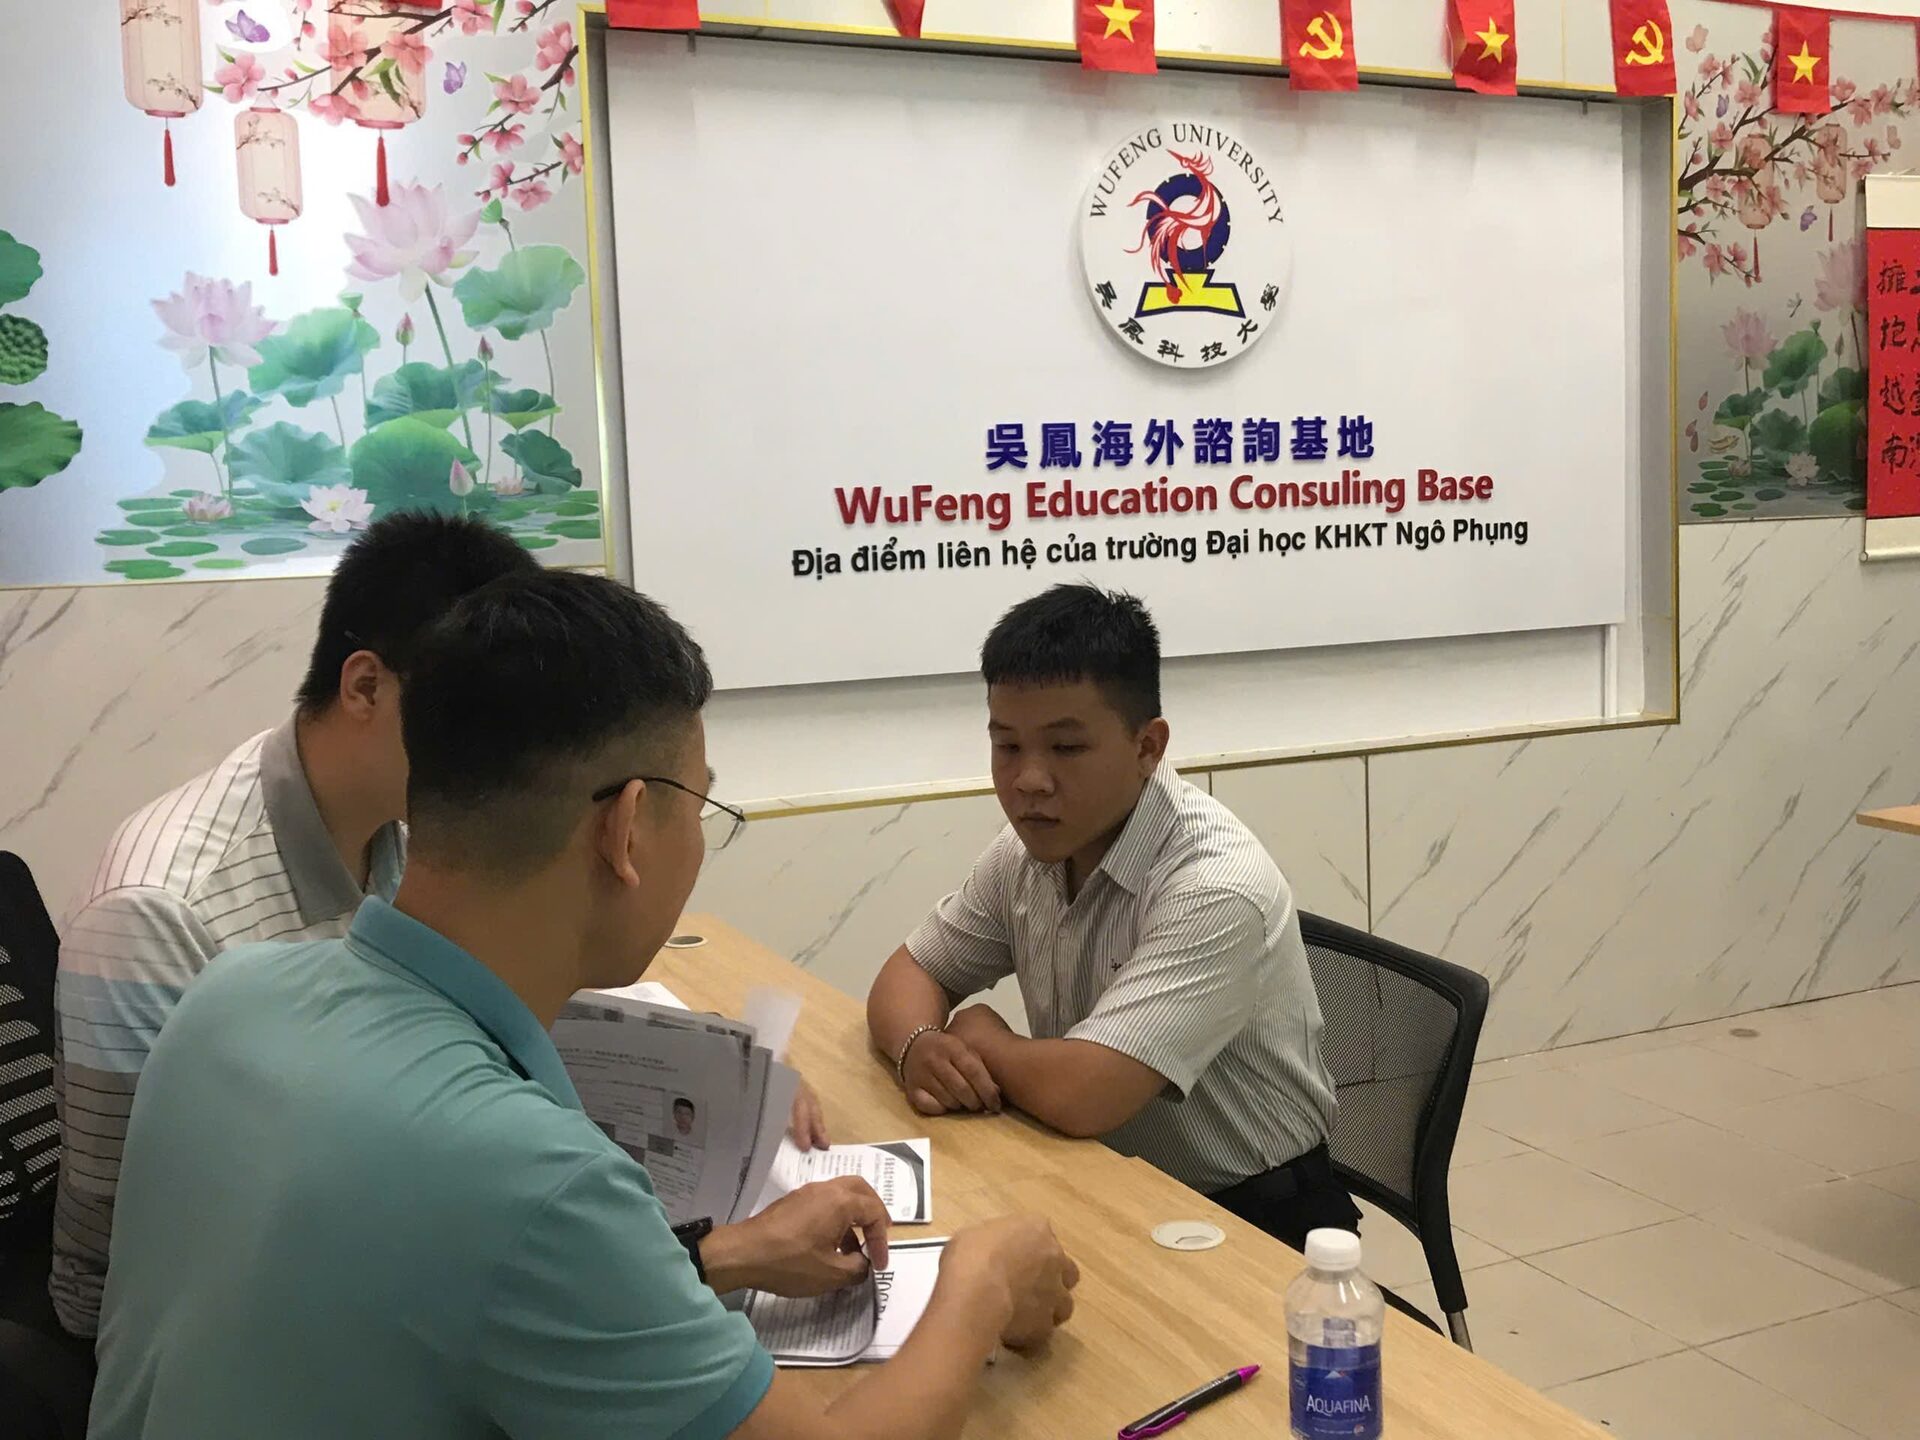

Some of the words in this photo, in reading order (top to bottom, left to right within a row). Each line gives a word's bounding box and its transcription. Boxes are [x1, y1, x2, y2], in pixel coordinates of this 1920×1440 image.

[1090, 128, 1162, 219] WUFENG
[1172, 123, 1284, 225] UNIVERSITY
[985, 414, 1375, 470] 吳鳳海外諮詢基地
[834, 484, 1012, 531] WuFeng
[1026, 475, 1218, 519] Education
[1229, 469, 1406, 514] Consuling
[1417, 468, 1494, 502] Base
[791, 547, 842, 580] Địa
[850, 536, 926, 573] điểm
[937, 540, 991, 569] liên
[1001, 540, 1038, 570] hệ
[1046, 533, 1097, 563] của
[1105, 532, 1197, 563] trường
[1206, 528, 1249, 559] Đại
[1258, 528, 1306, 557] học
[1315, 522, 1388, 549] KHKT
[1395, 518, 1446, 550] Ngô
[1453, 517, 1529, 546] Phụng
[1306, 1394, 1371, 1417] AQUAFINA
